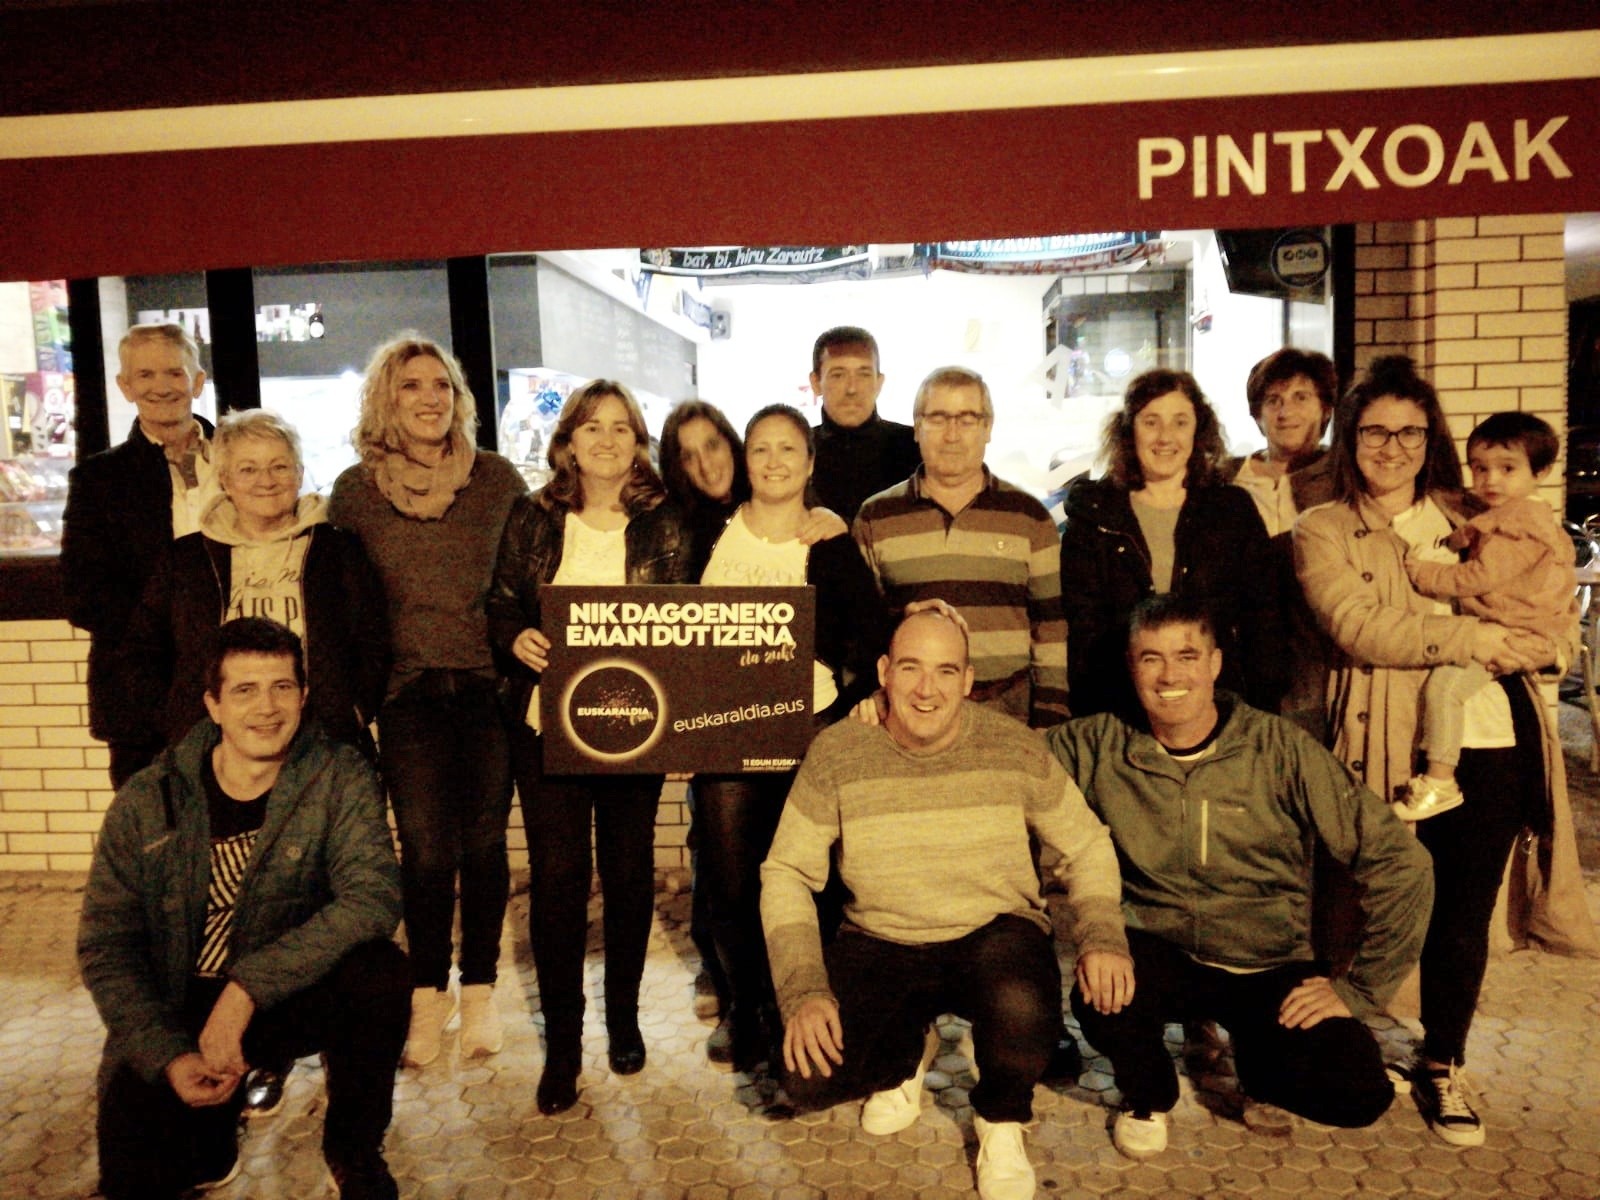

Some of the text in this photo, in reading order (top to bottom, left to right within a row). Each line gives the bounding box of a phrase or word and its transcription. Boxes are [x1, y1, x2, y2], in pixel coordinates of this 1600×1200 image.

[1137, 115, 1574, 200] PINTXOAK
[682, 246, 825, 269] bat, bi, hiru Zarautz
[569, 602, 795, 624] NIK DAGOENEKO
[566, 625, 795, 647] EMAN DUT IZENA
[577, 707, 649, 717] EUSKARALDIA
[673, 699, 805, 733] euskaraldia.eus
[750, 758, 772, 767] EGUN
